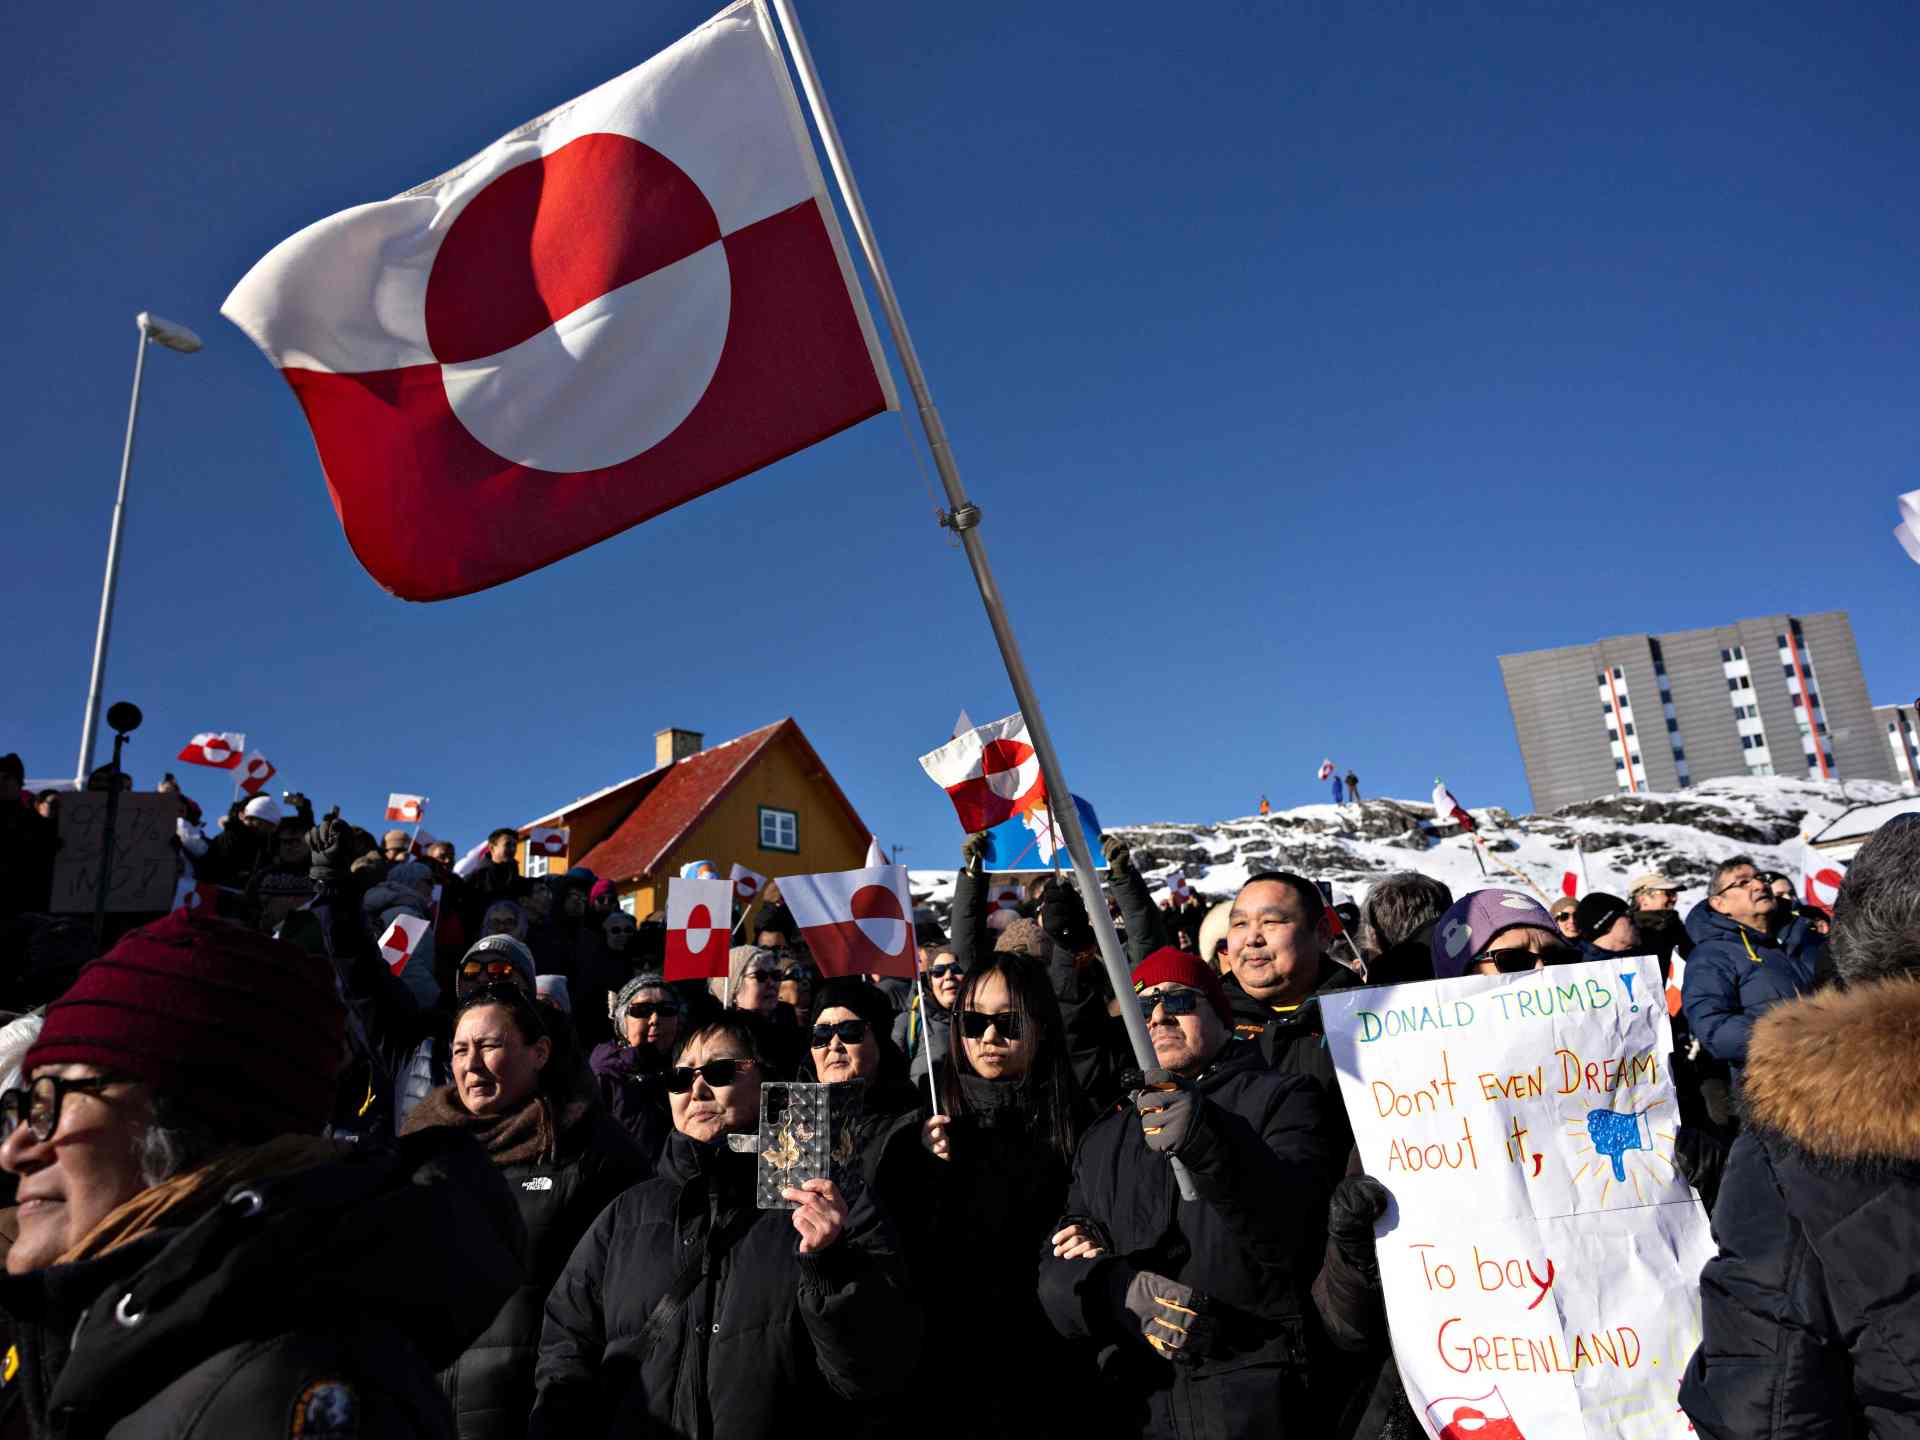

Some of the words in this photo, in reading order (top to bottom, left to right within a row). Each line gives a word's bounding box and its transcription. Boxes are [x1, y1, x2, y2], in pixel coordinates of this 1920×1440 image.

[1358, 1002, 1474, 1042] DONALD
[1372, 1051, 1457, 1118] Don't
[1479, 1066, 1543, 1101] EVEN
[1555, 1049, 1657, 1095] DREAM
[1388, 1117, 1478, 1172] About
[1506, 1116, 1544, 1177] it,
[1409, 1244, 1456, 1291] To
[1473, 1245, 1555, 1310] bay
